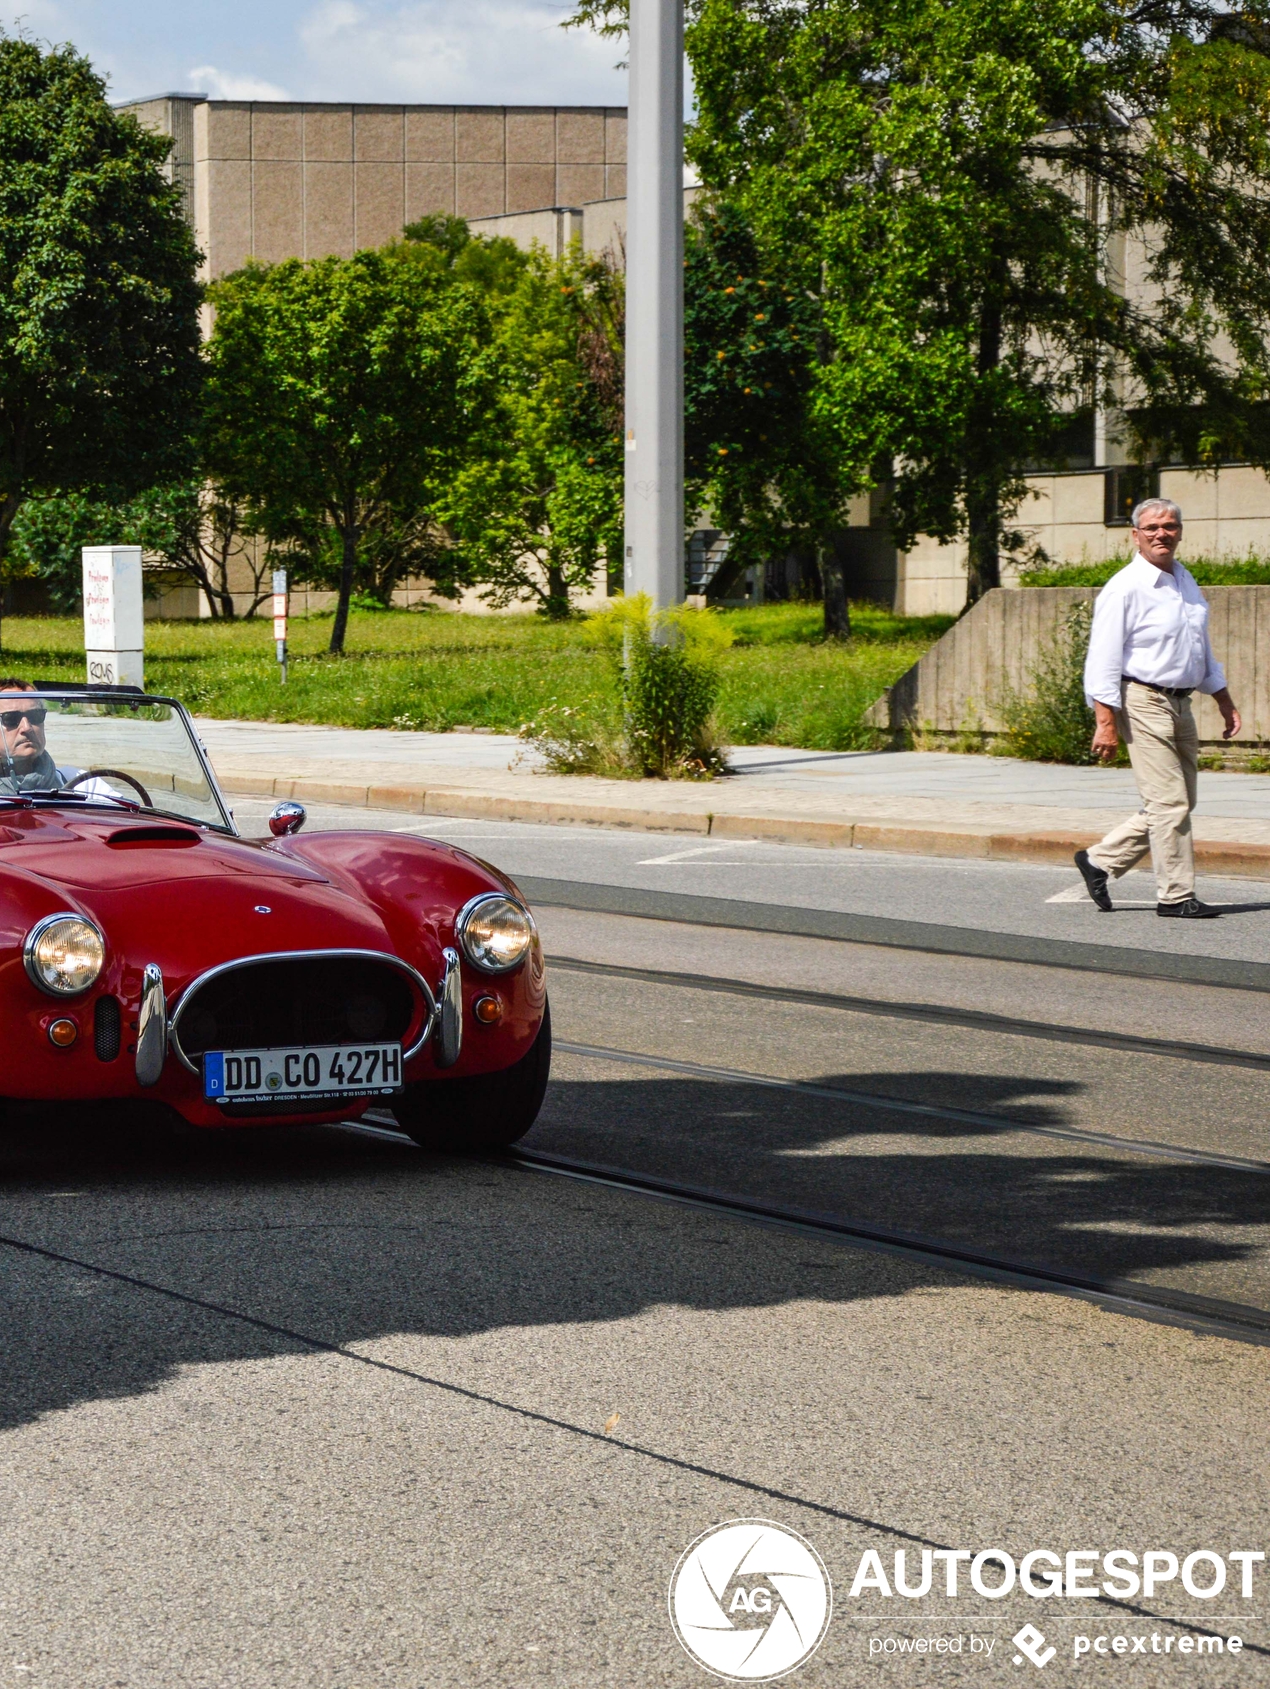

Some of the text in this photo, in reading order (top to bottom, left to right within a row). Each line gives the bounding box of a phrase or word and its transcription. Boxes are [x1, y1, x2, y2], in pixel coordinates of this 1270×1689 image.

[225, 1048, 399, 1091] DD CO 427H
[211, 1079, 218, 1089] D
